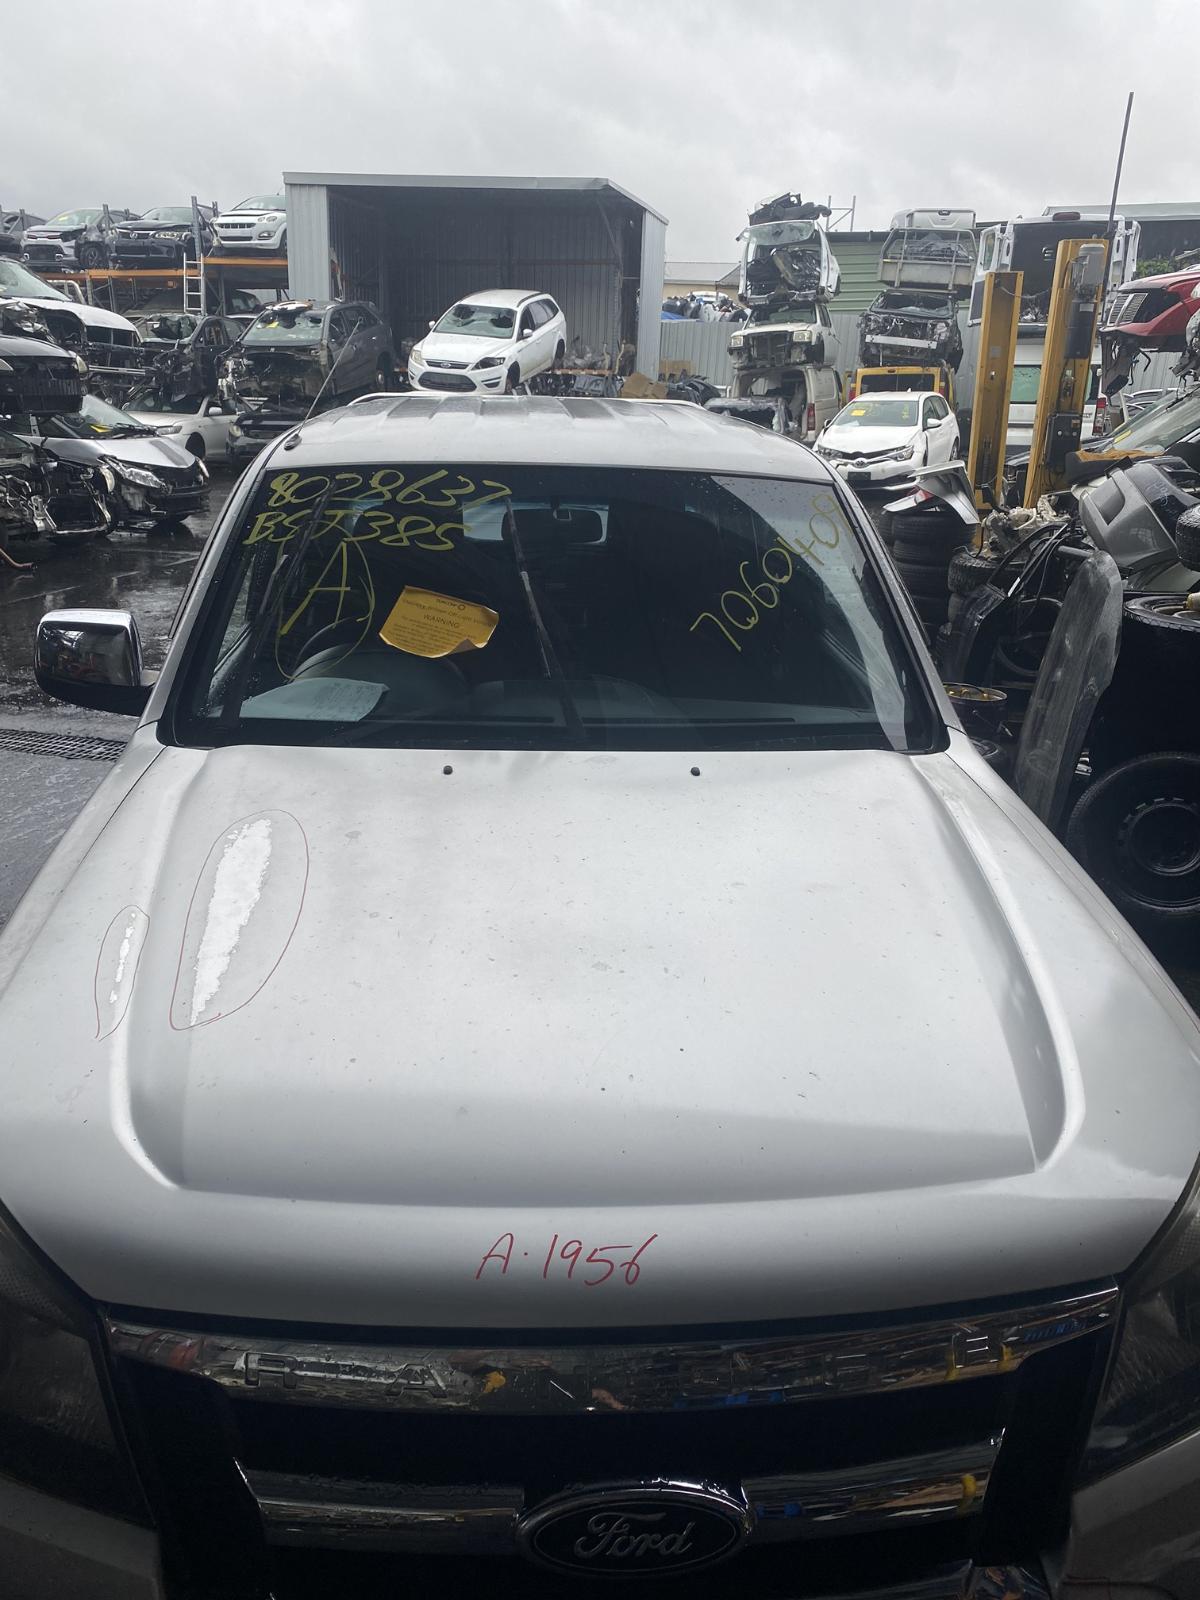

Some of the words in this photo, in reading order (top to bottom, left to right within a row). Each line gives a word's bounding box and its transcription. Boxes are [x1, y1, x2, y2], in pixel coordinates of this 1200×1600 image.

[280, 538, 352, 636] A
[689, 493, 854, 652] 7060409
[423, 613, 462, 629] WARNING
[244, 1333, 1003, 1400] RAER
[573, 1511, 697, 1559] Ford
